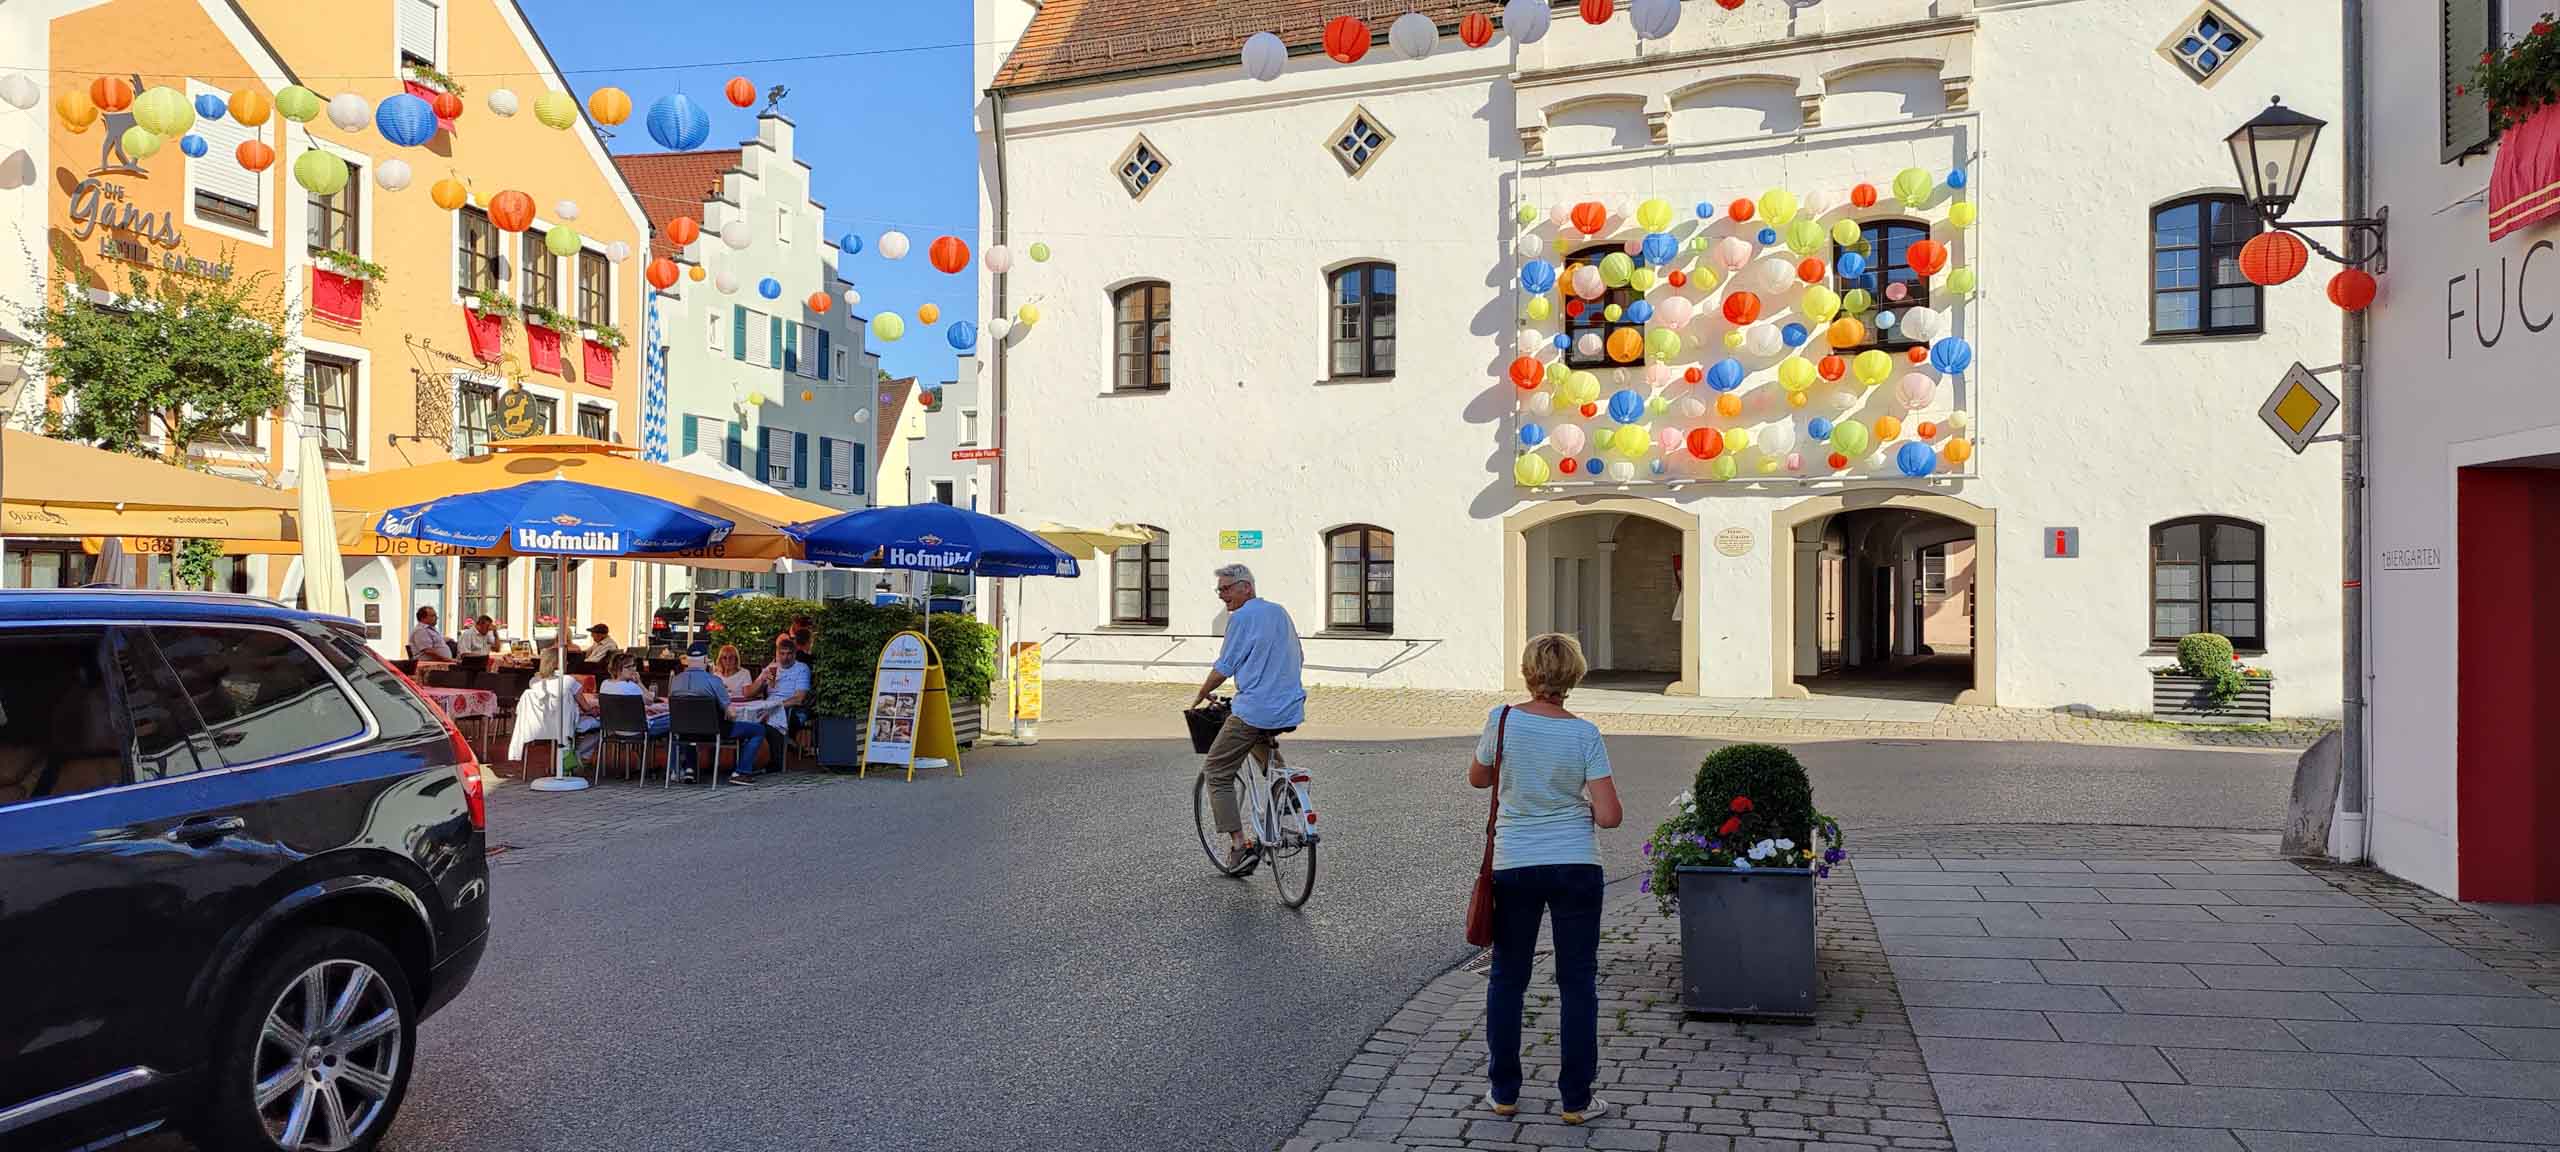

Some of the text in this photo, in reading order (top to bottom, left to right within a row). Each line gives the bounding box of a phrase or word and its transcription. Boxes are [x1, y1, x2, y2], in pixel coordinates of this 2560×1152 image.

[102, 182, 125, 202] DIE
[376, 536, 409, 554] Die
[519, 528, 619, 551] Hofmühl
[2386, 548, 2440, 567] BIERGARTEN
